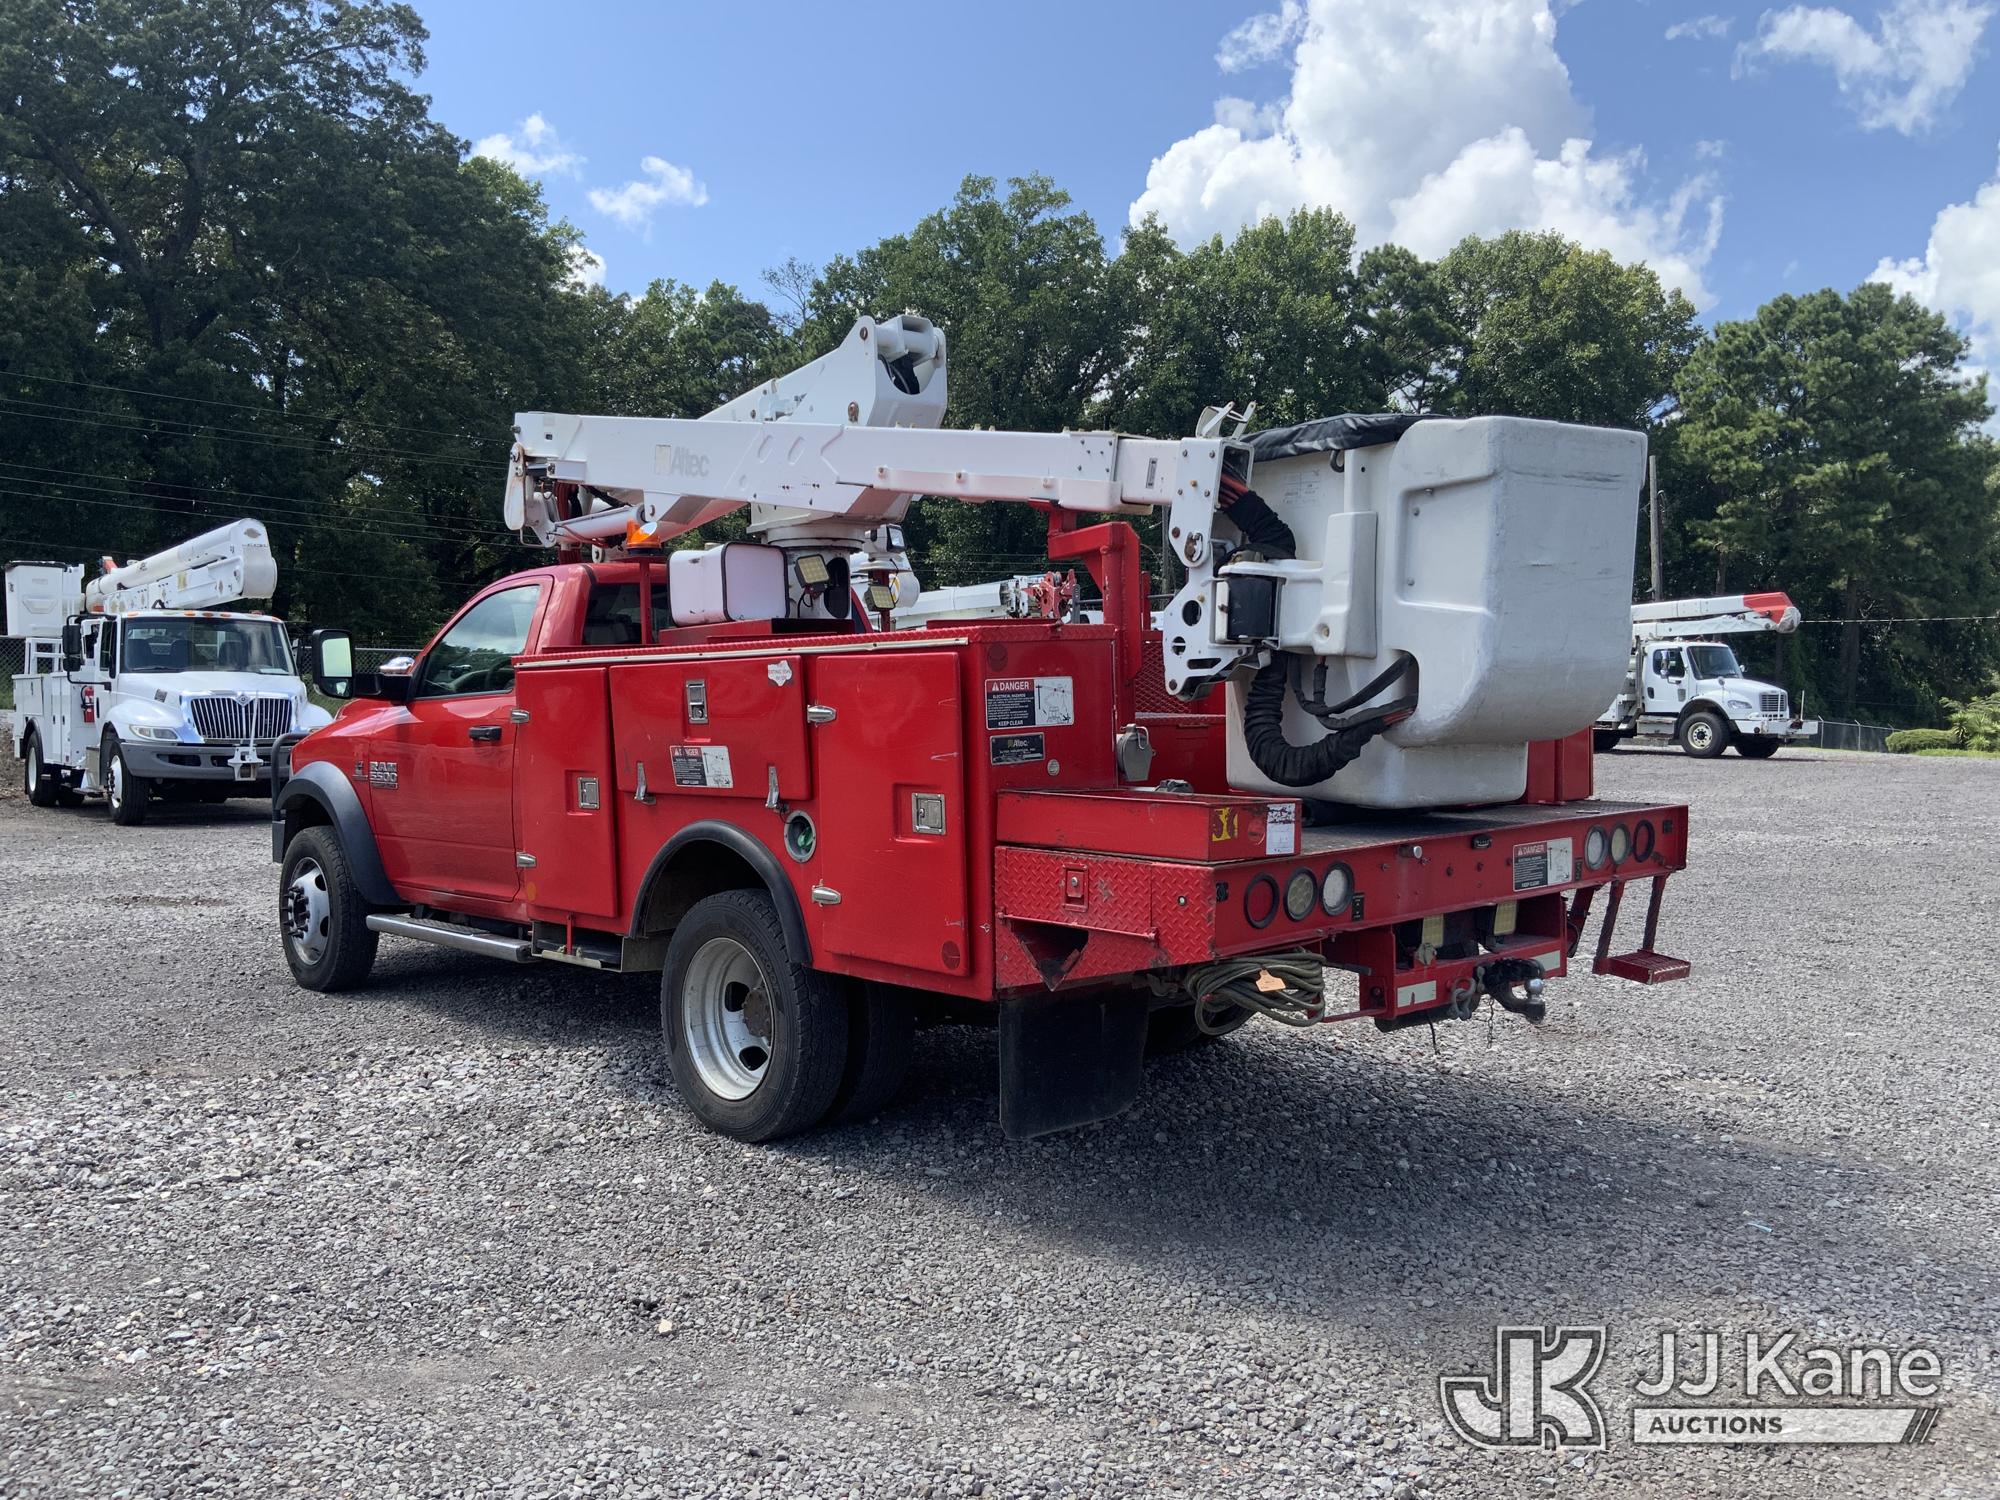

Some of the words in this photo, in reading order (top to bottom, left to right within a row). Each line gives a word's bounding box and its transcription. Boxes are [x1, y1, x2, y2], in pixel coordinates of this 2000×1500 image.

[672, 446, 710, 477] Altec
[1000, 681, 1030, 691] DANGER
[369, 761, 397, 772] RAM
[369, 771, 398, 783] 5500
